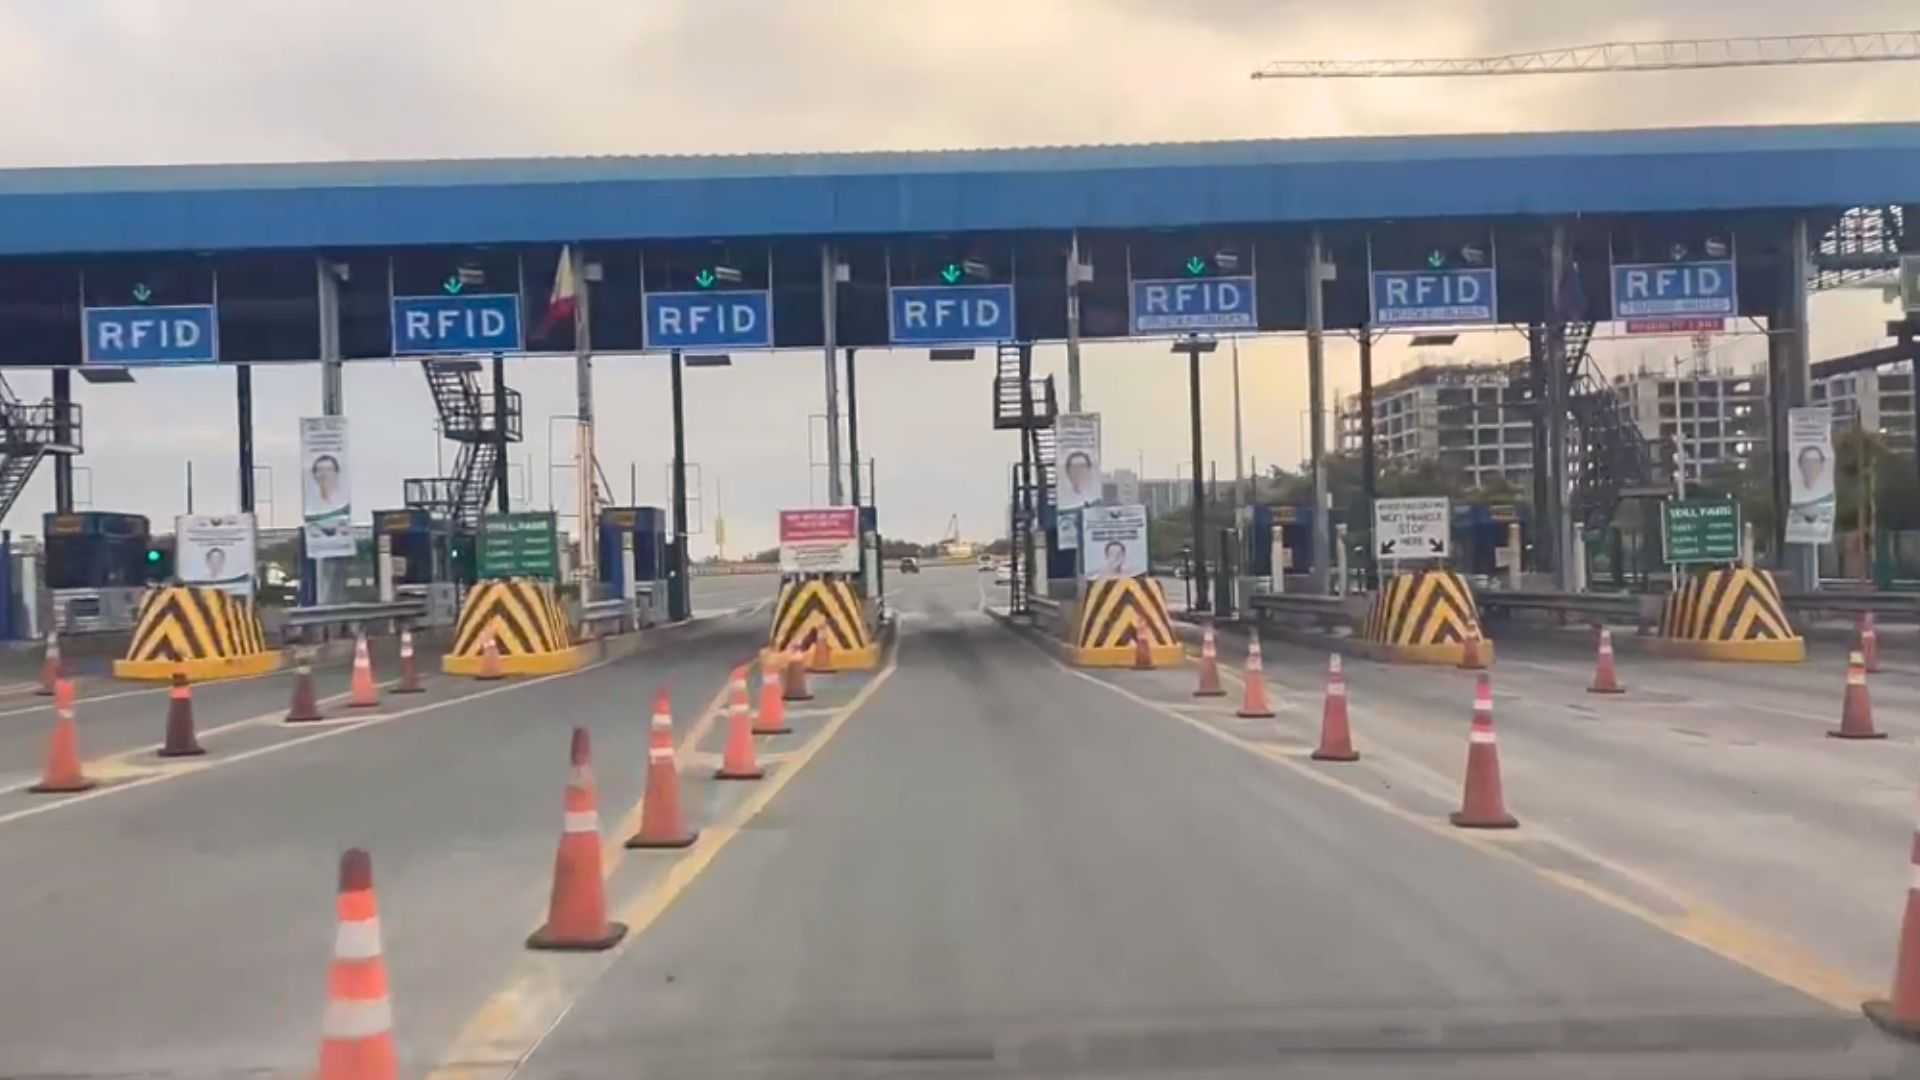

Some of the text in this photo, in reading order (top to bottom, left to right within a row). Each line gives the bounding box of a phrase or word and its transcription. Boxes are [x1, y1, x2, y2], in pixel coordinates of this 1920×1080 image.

[1146, 283, 1240, 312] RFID
[1387, 275, 1480, 305] RFID
[1627, 268, 1721, 298] RFID
[406, 311, 504, 339] RFID
[658, 305, 756, 334] RFID
[905, 300, 998, 327] RFID
[99, 320, 200, 349] RFID
